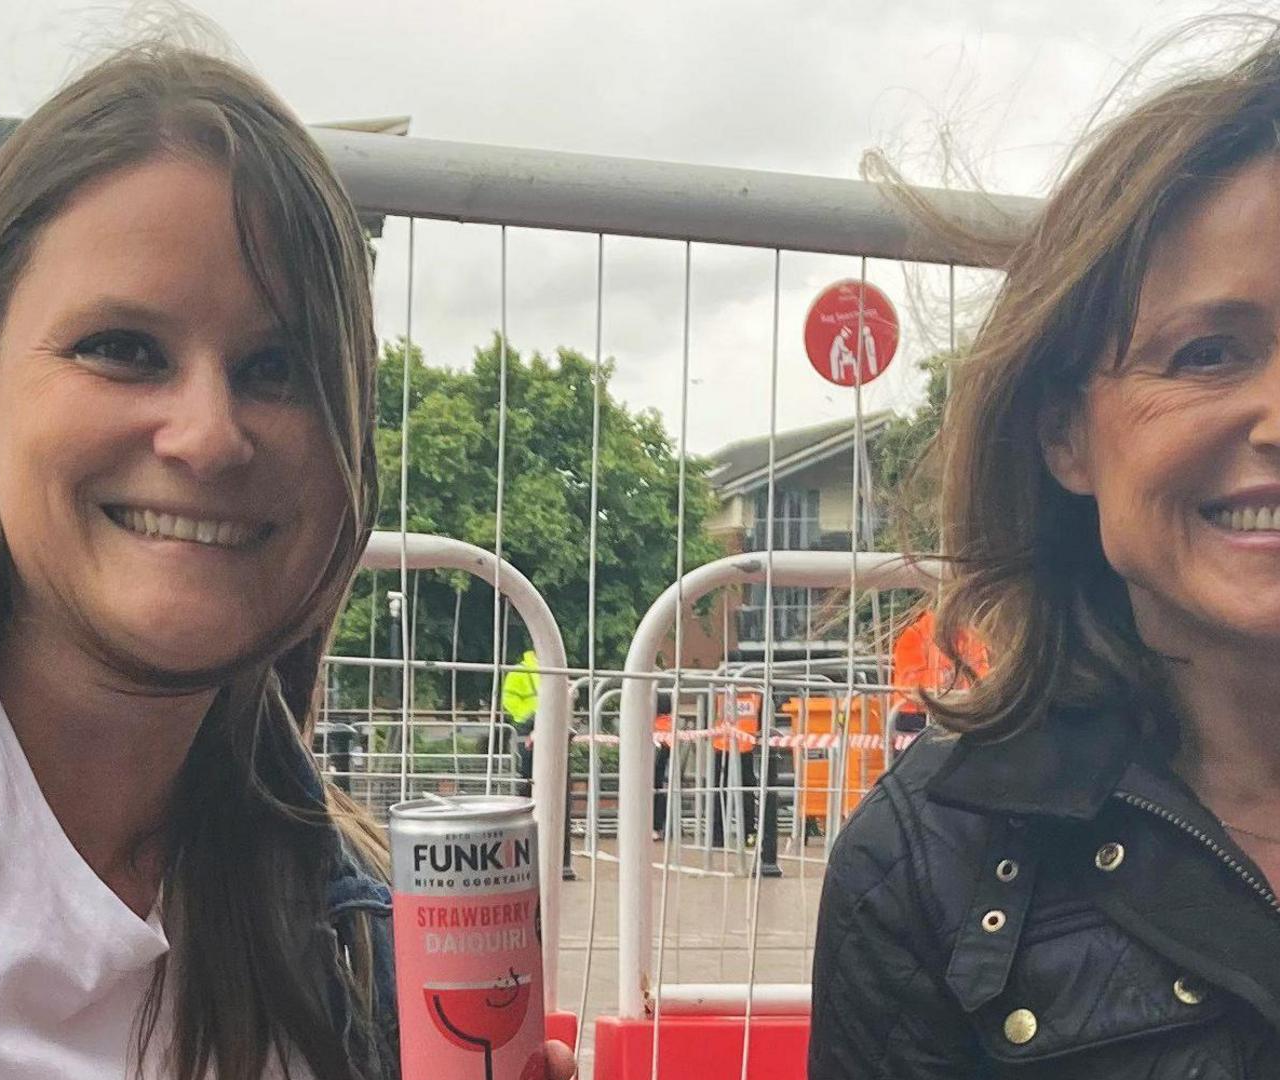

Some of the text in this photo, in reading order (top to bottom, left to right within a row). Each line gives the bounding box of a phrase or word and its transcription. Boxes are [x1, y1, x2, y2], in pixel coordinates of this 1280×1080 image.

[413, 837, 531, 873] FUNKIN
[414, 878, 455, 888] NITRO
[417, 900, 530, 928] STRAWBERRY
[425, 927, 527, 955] DAIQUIRI
